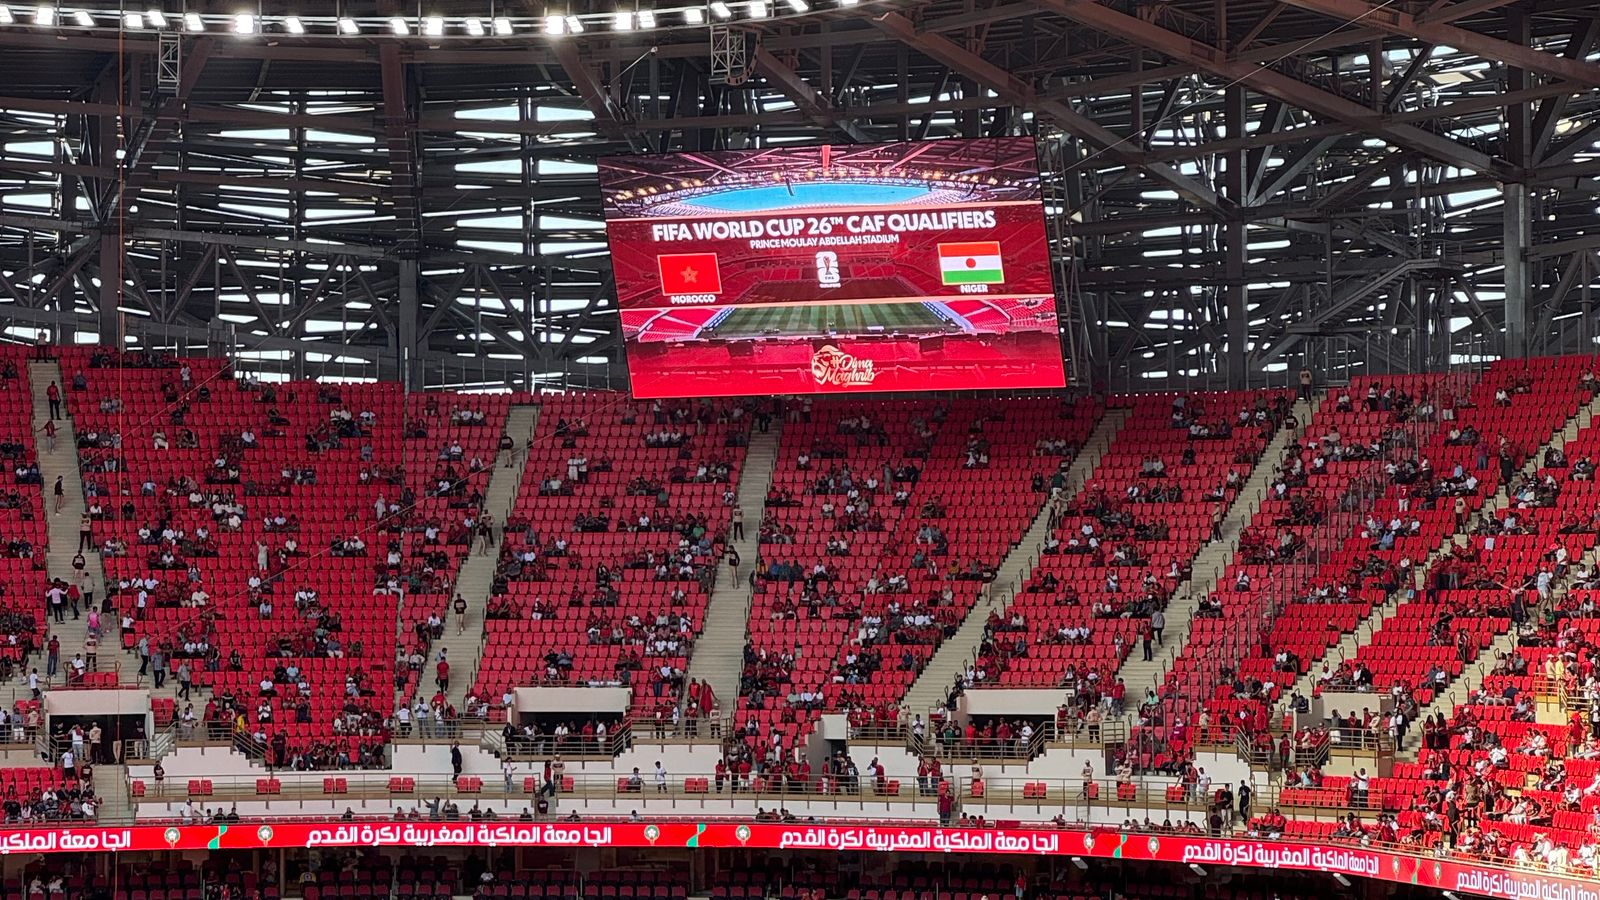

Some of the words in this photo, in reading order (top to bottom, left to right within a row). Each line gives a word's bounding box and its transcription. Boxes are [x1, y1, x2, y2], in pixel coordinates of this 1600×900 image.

[652, 223, 693, 242] FIFA
[692, 220, 764, 240] WORLD
[766, 218, 805, 237] CUP
[846, 214, 885, 233] CAF
[887, 210, 997, 232] QUALIFIERS
[750, 239, 781, 249] PRINCE
[781, 237, 817, 248] MOULAY
[819, 235, 862, 246] ABDELLAH
[862, 234, 899, 245] STADIUM
[671, 294, 716, 304] MOROCCO
[960, 284, 988, 293] NIGER
[0, 832, 56, 854] الملكي
[306, 826, 358, 848] القدم
[361, 825, 400, 846] لكرة
[403, 824, 474, 847] المغربية
[477, 825, 540, 847] الملكية
[780, 828, 825, 849] القدم
[827, 828, 863, 850] لكرة
[866, 827, 930, 852] المغربية
[933, 829, 992, 853] الملكية
[1183, 843, 1221, 863] القدم
[1222, 843, 1252, 865] لكرة
[1254, 844, 1309, 868] المغربية
[1311, 847, 1348, 872] الملكية
[1456, 870, 1482, 892] القدم
[1482, 871, 1503, 896] لكرة
